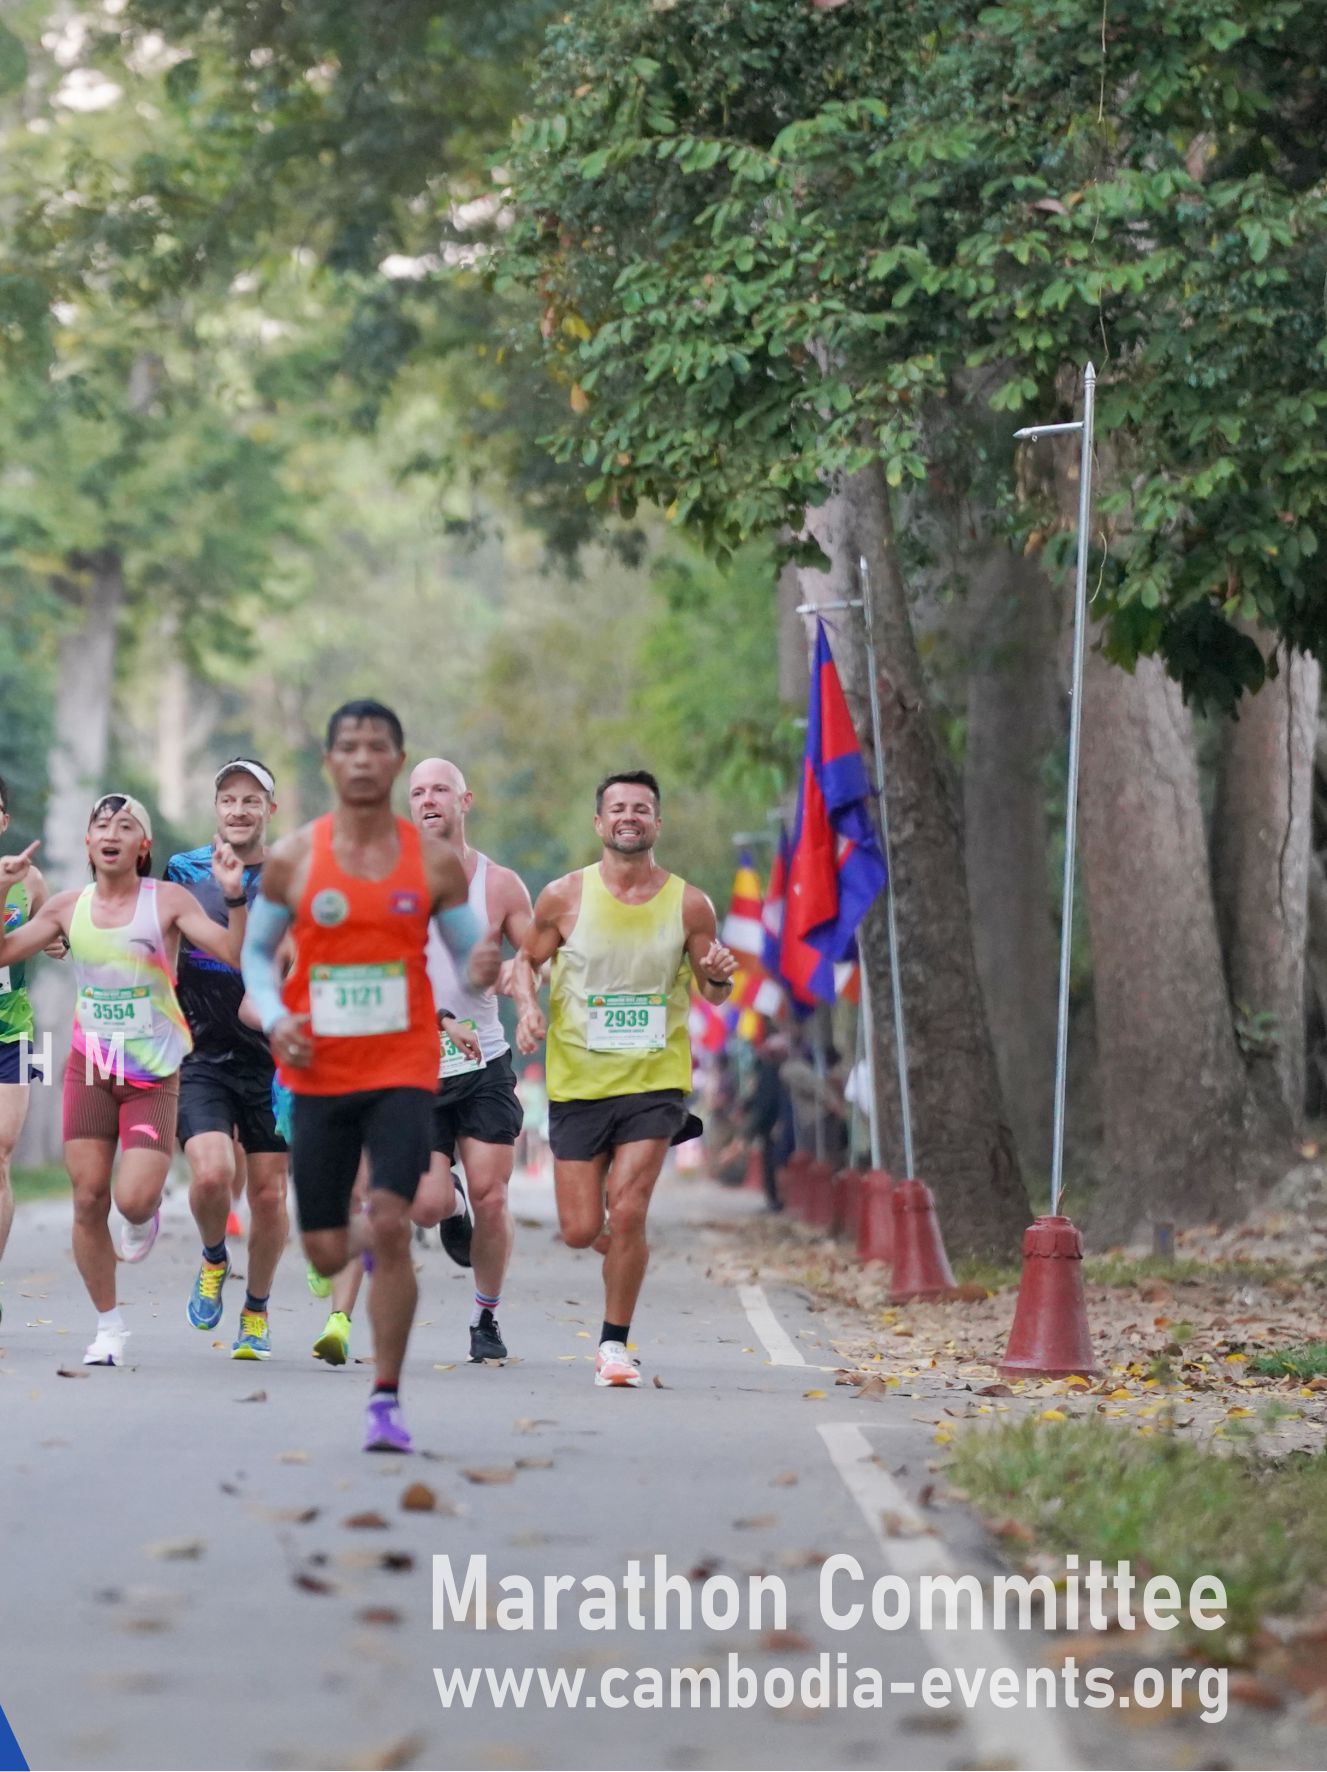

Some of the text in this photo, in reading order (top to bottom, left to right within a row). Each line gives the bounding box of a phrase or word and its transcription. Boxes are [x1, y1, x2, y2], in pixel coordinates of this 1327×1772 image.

[335, 985, 383, 1008] 3121
[93, 1003, 135, 1020] 3554
[604, 1009, 649, 1028] 2939
